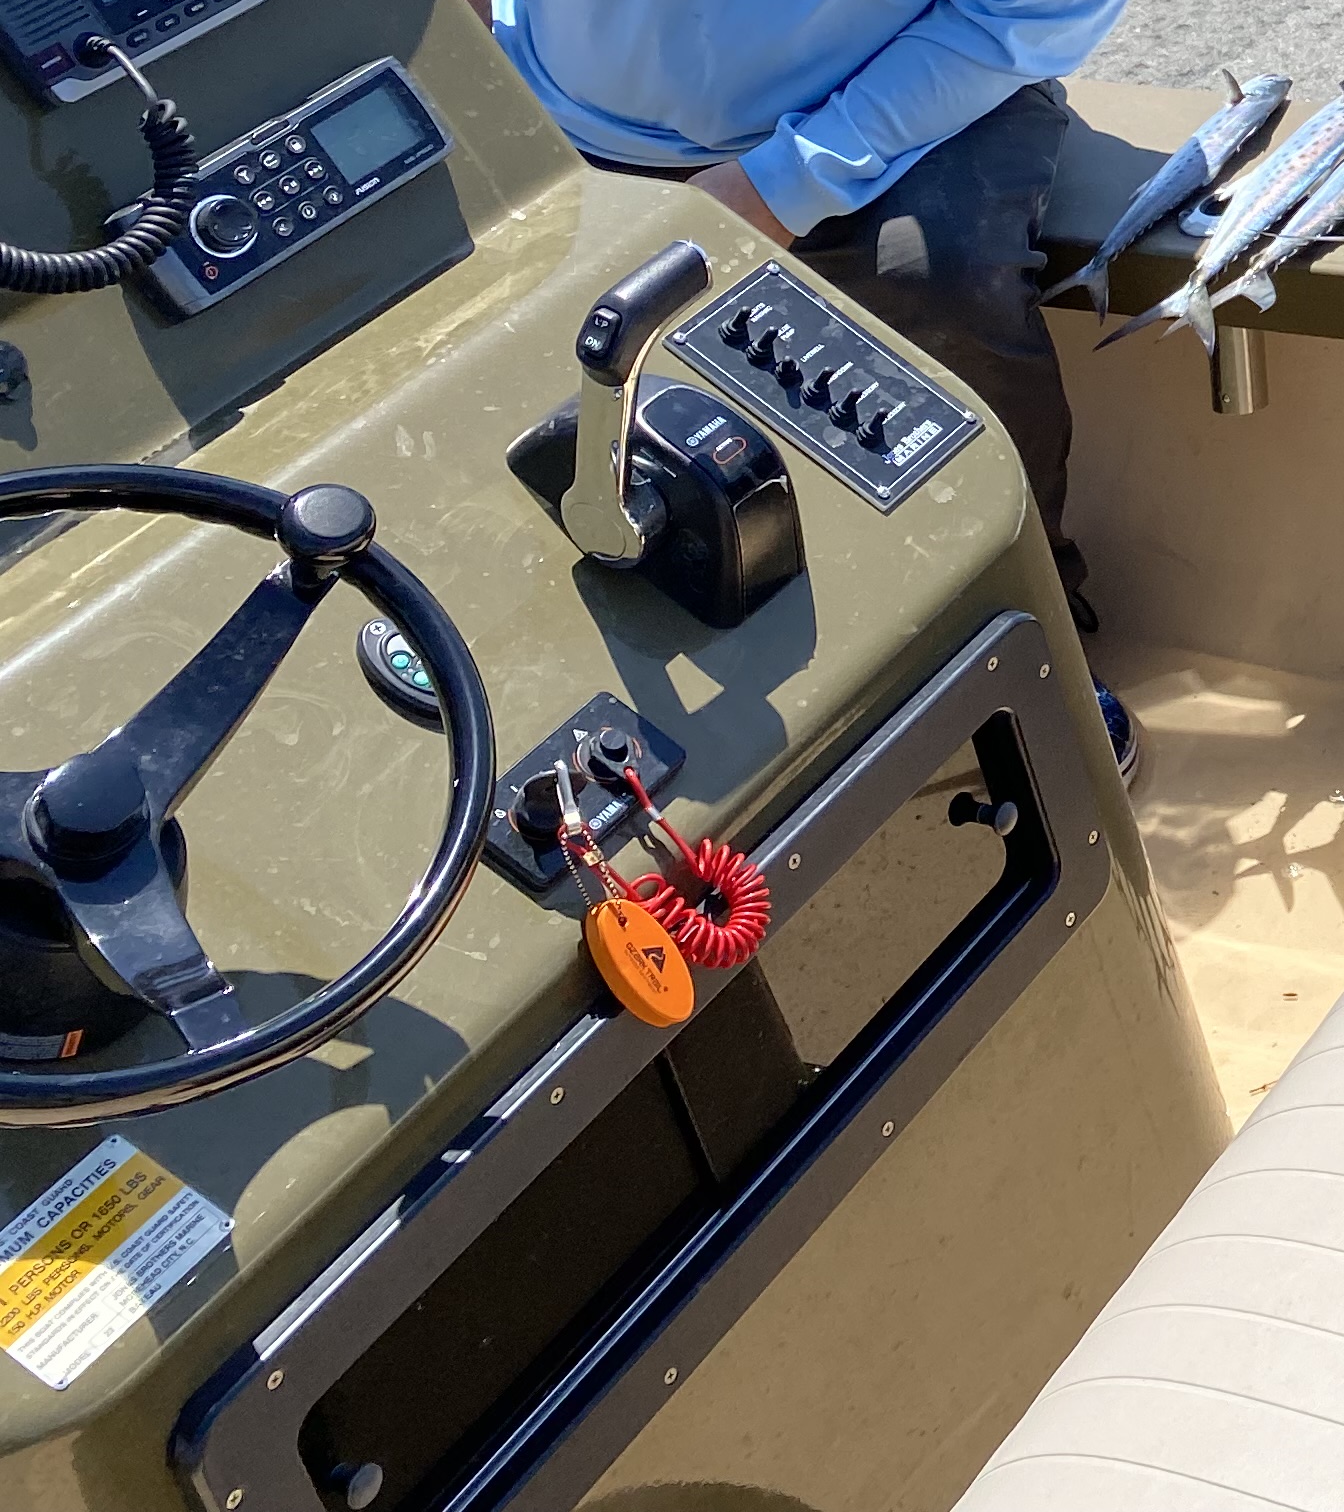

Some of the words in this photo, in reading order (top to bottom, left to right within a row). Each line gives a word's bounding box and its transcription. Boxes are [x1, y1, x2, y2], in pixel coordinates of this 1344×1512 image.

[594, 316, 609, 328] UP
[693, 416, 727, 441] YAMAHA
[36, 1158, 117, 1229] CAPACITIES
[137, 1175, 167, 1201] GEAR
[9, 1209, 40, 1235] COAST
[9, 1240, 72, 1295] PERSONS
[70, 1221, 93, 1240] OR
[91, 1194, 122, 1222] 1650
[119, 1171, 147, 1196] LBS
[136, 1241, 177, 1277] BROTHERS
[44, 1269, 81, 1304] MOTOR
